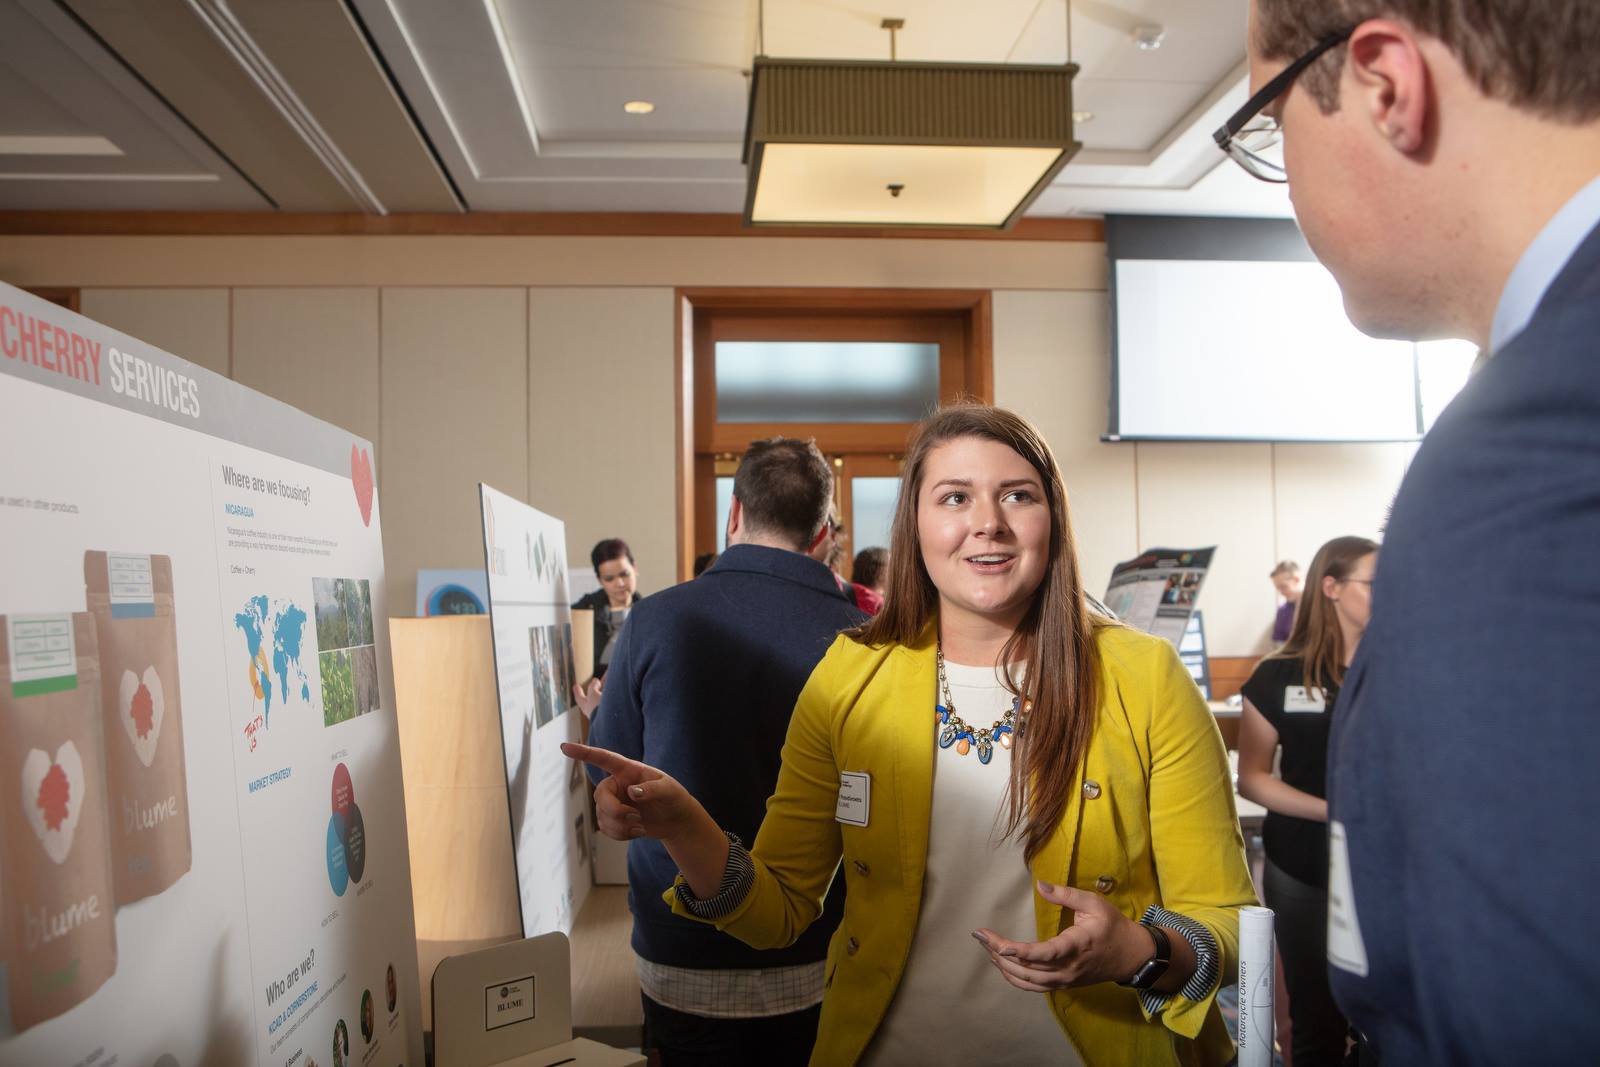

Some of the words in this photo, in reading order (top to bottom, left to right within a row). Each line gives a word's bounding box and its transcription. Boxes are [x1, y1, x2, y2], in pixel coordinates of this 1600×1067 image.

[0, 305, 102, 386] CHERRY
[108, 347, 200, 418] SERVICES
[222, 464, 250, 490] Where
[252, 477, 265, 493] are
[266, 480, 278, 496] we
[278, 479, 311, 507] focusing?
[225, 503, 255, 518] NICARAGUA
[249, 775, 269, 793] MARKET
[269, 767, 292, 784] STRATEGY
[123, 795, 178, 833] blume
[24, 895, 100, 951] blume
[266, 980, 286, 1007] Who
[287, 967, 300, 989] are
[300, 948, 315, 976] we?
[1239, 960, 1247, 996] Owners
[268, 1015, 283, 1034] KCAD
[287, 981, 318, 1018] CORNERSTONE
[497, 999, 523, 1012] BLUME
[1239, 997, 1248, 1048] Motorcycle
